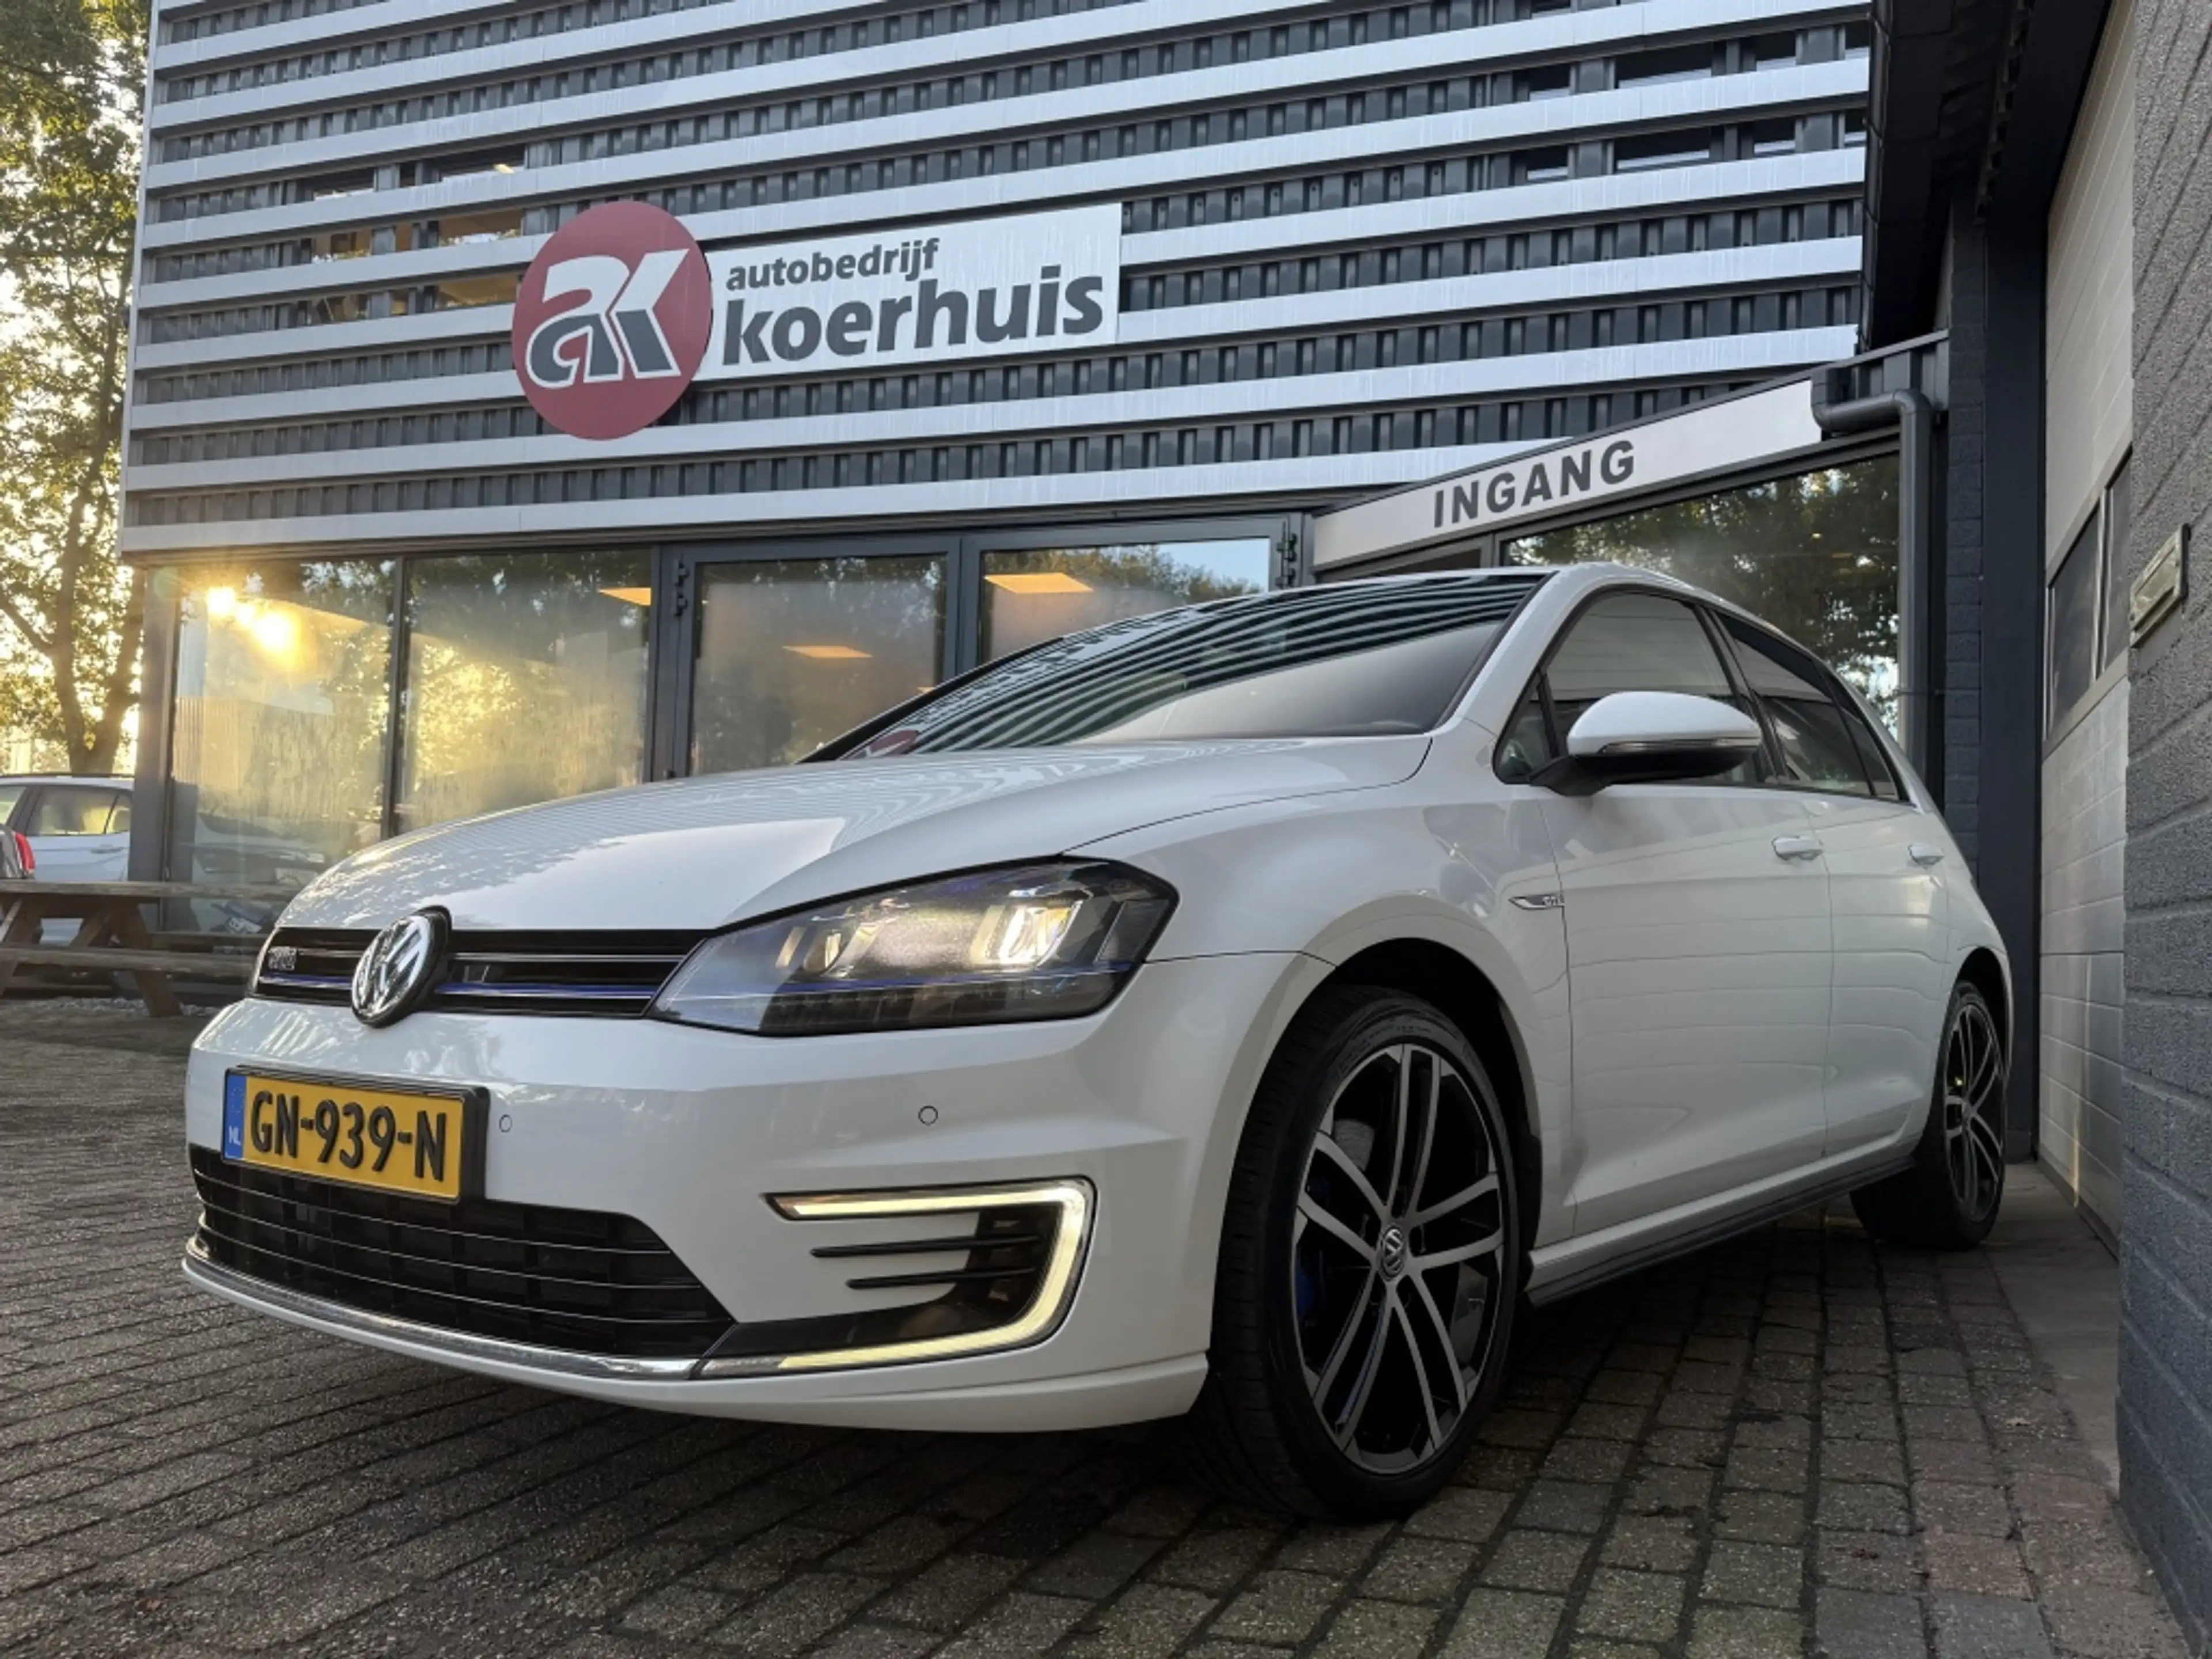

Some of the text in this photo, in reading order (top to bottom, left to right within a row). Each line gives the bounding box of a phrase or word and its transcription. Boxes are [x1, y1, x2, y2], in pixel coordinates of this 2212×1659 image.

[726, 238, 939, 291] autobedrijf
[722, 265, 1104, 366] koerhuis
[1434, 440, 1634, 528] INGANG
[229, 1125, 241, 1146] NL
[251, 1090, 446, 1181] GN-939-N
